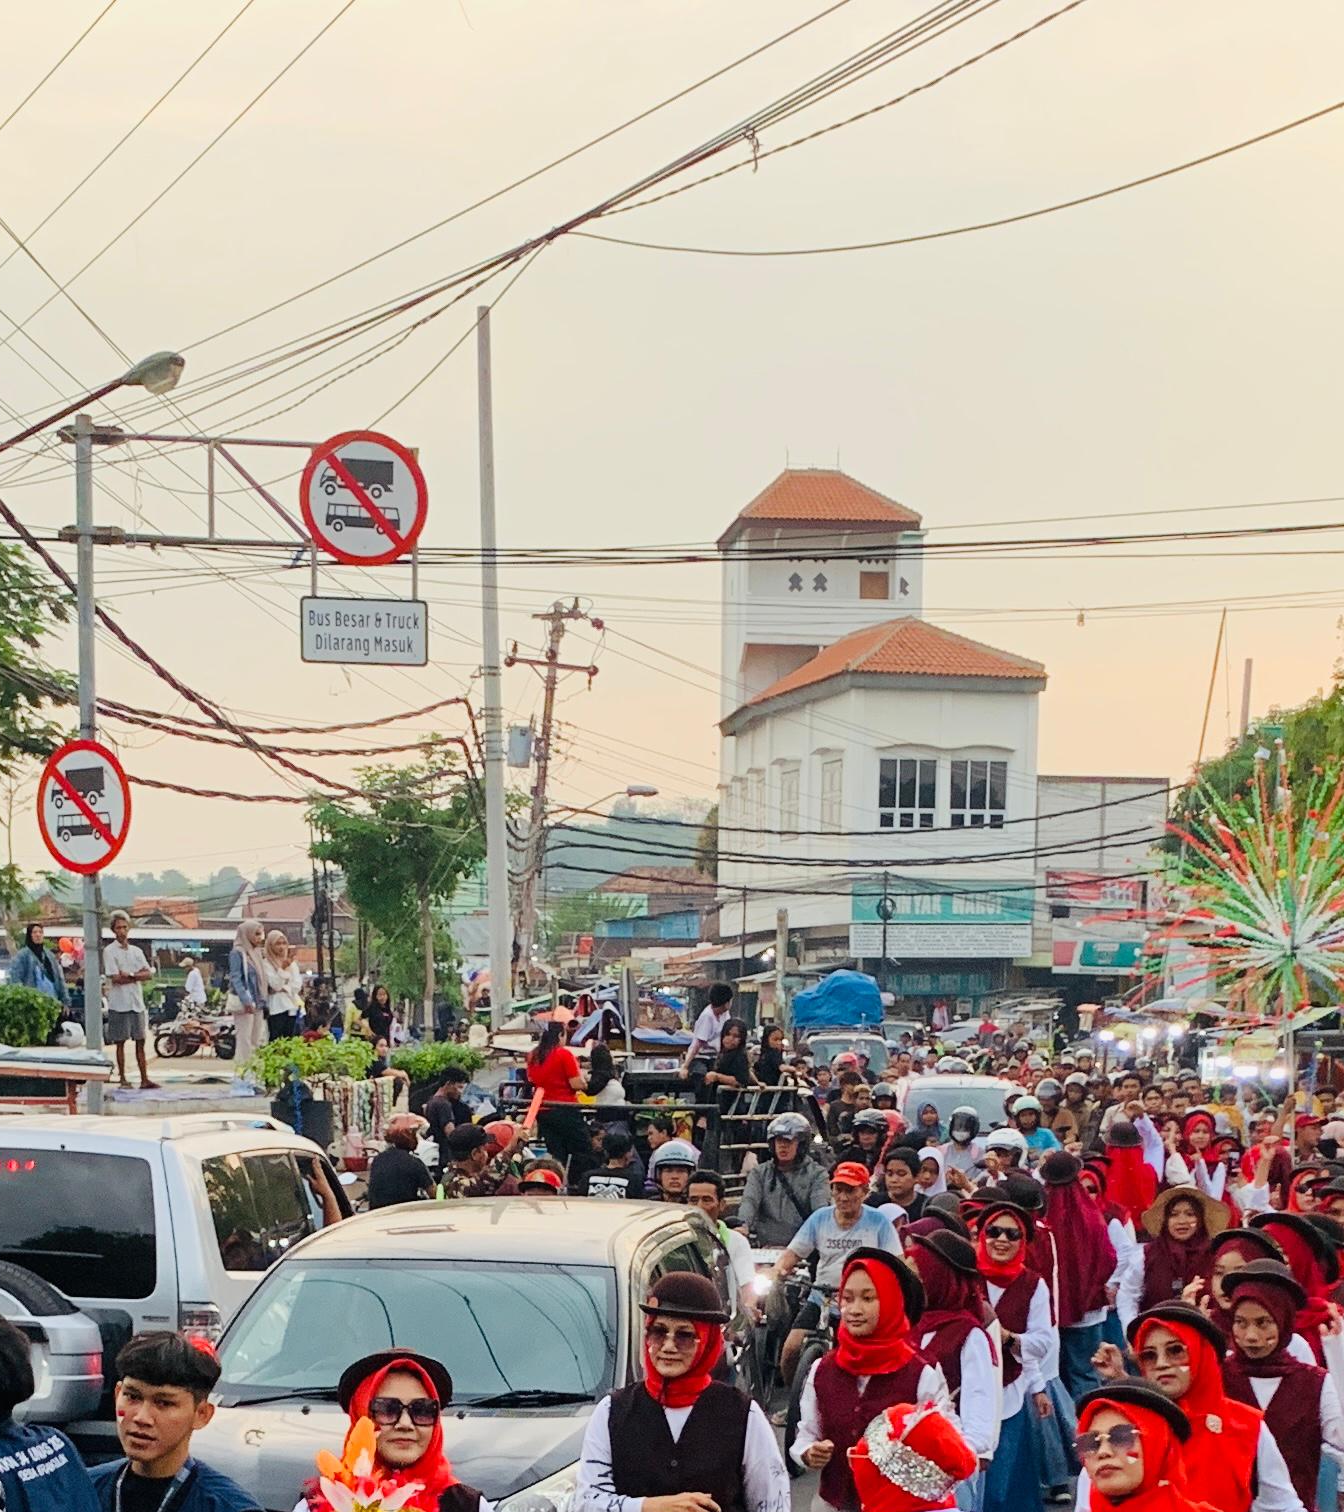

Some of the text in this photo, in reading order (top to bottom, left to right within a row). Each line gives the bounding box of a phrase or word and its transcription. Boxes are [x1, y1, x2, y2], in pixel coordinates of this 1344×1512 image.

[308, 609, 420, 630] Bus Besar & Truck
[315, 632, 414, 656] Dilarang Masuk
